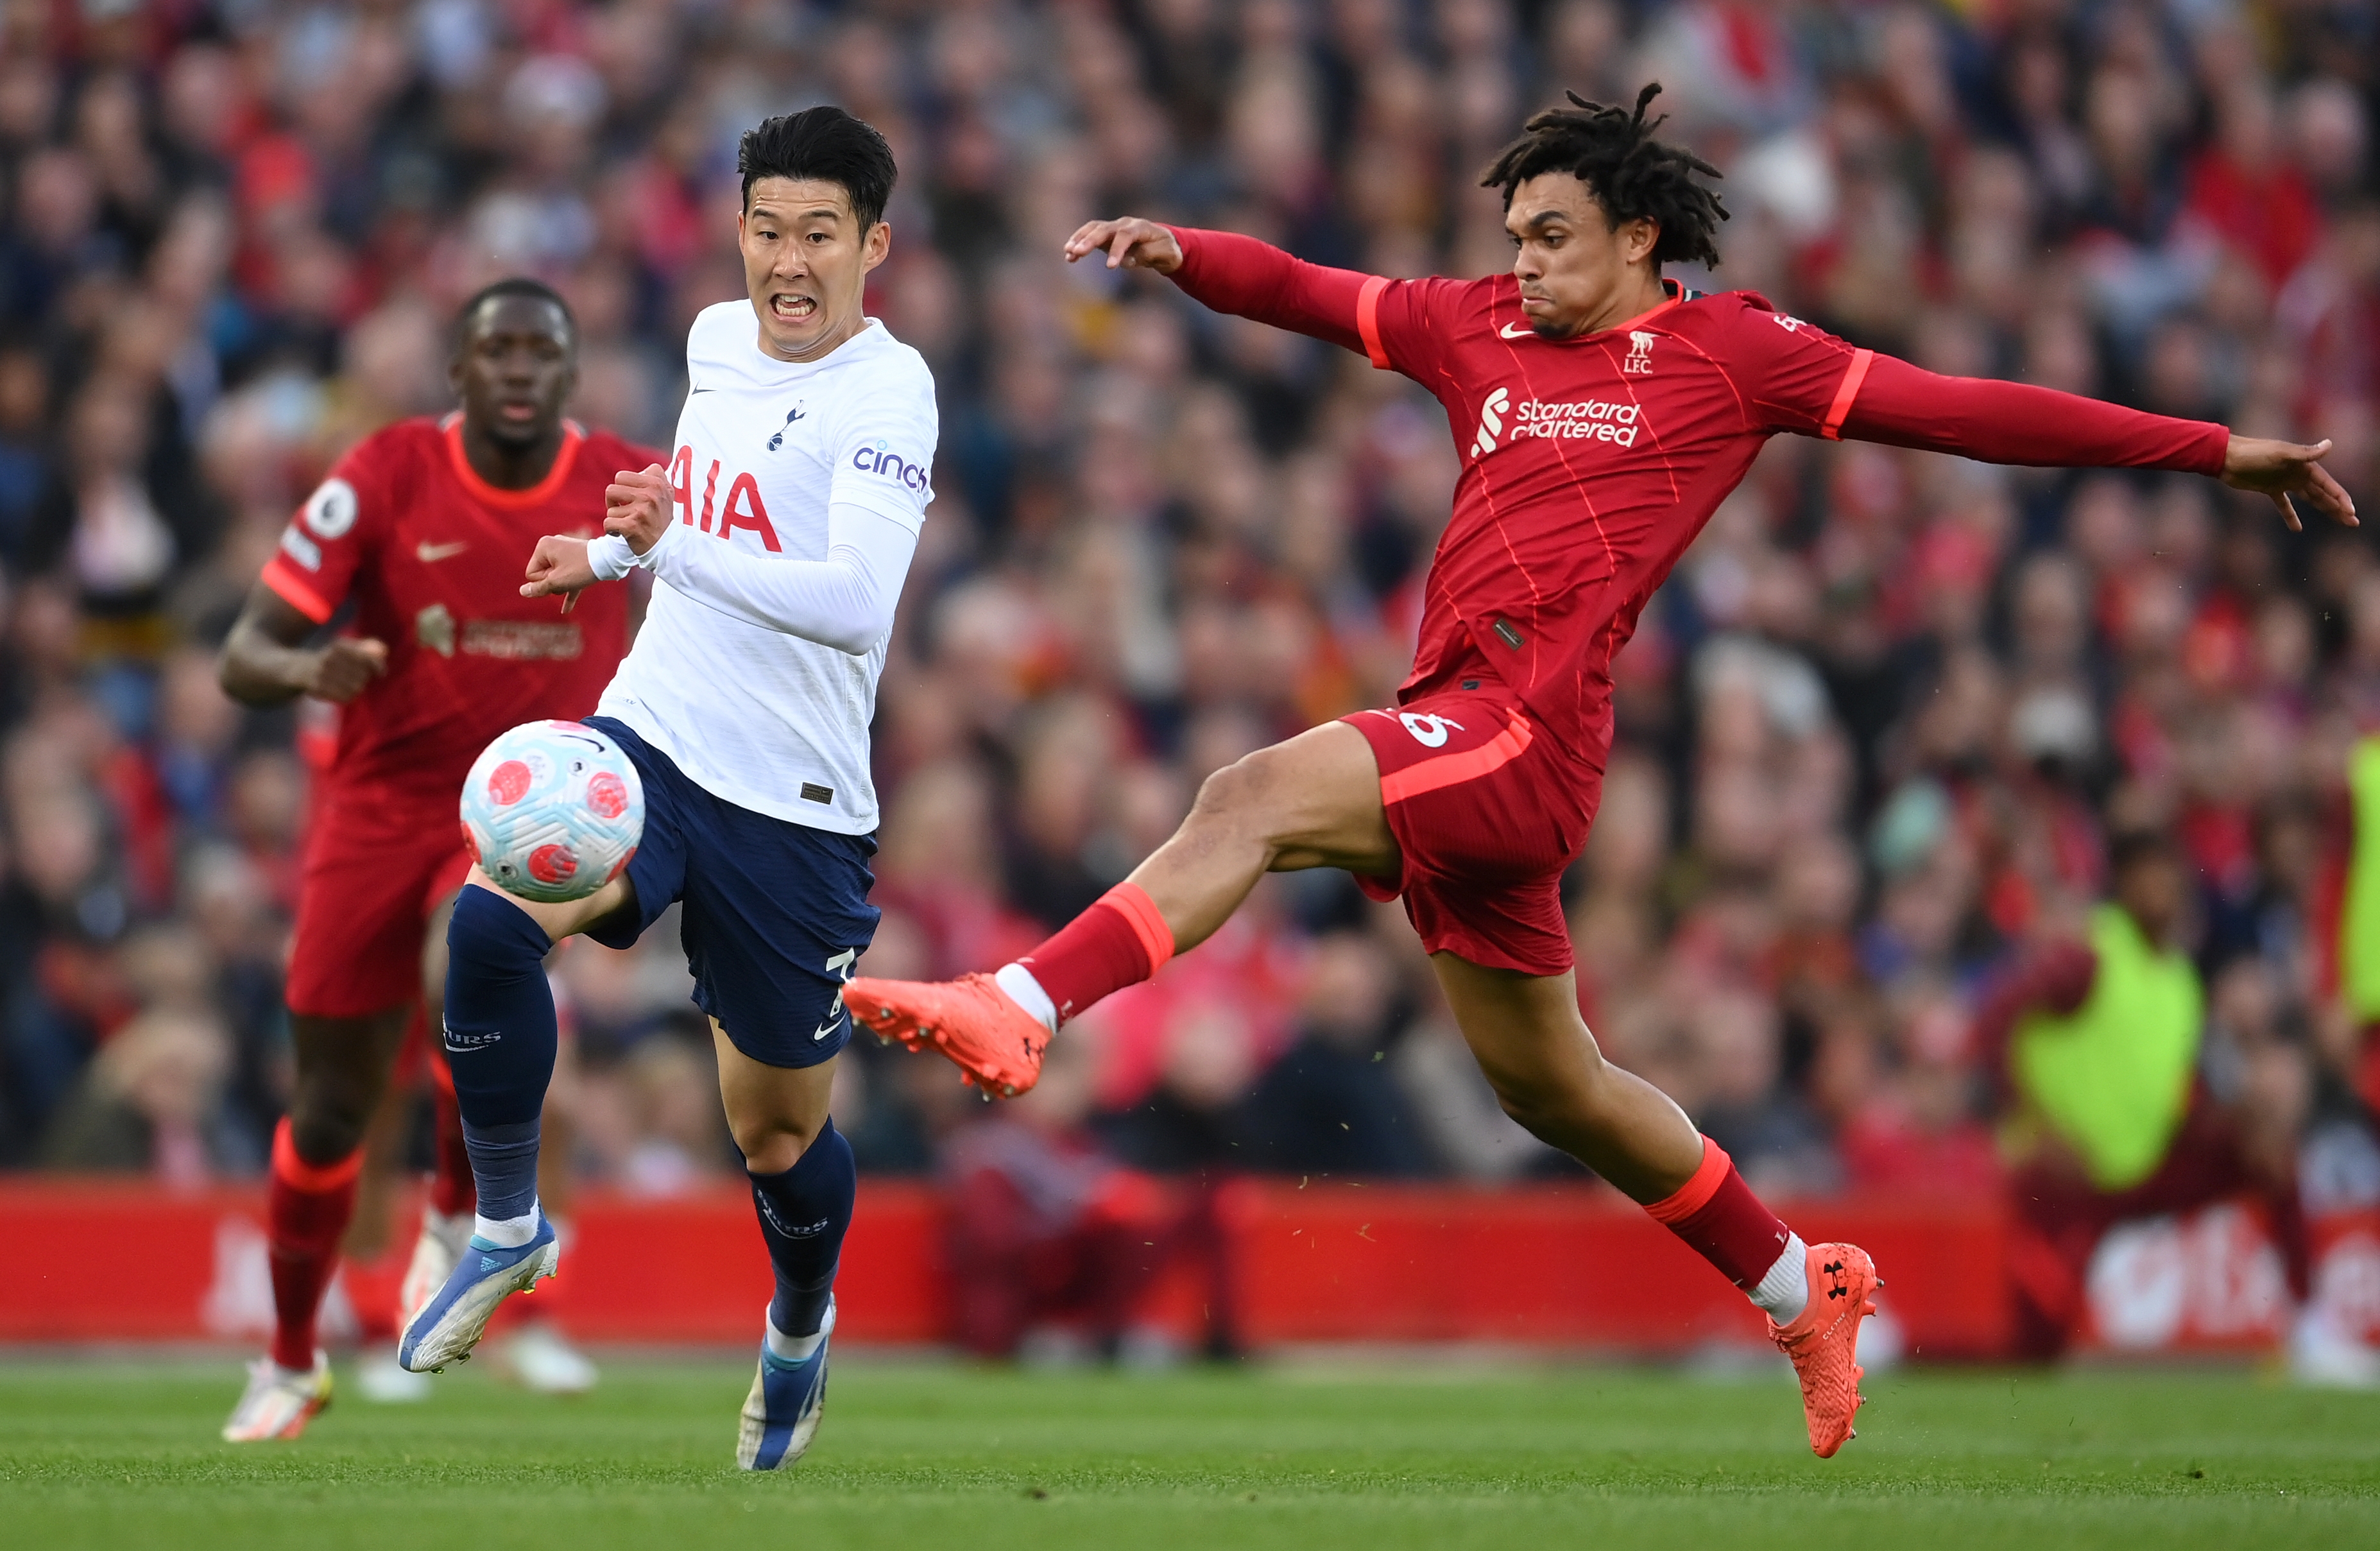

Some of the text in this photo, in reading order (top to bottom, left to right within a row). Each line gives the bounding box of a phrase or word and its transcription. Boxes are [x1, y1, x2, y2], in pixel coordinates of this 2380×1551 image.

[1516, 398, 1641, 424] standard
[853, 440, 927, 494] cinch
[671, 445, 783, 553] AIA
[826, 946, 855, 1018] 7
